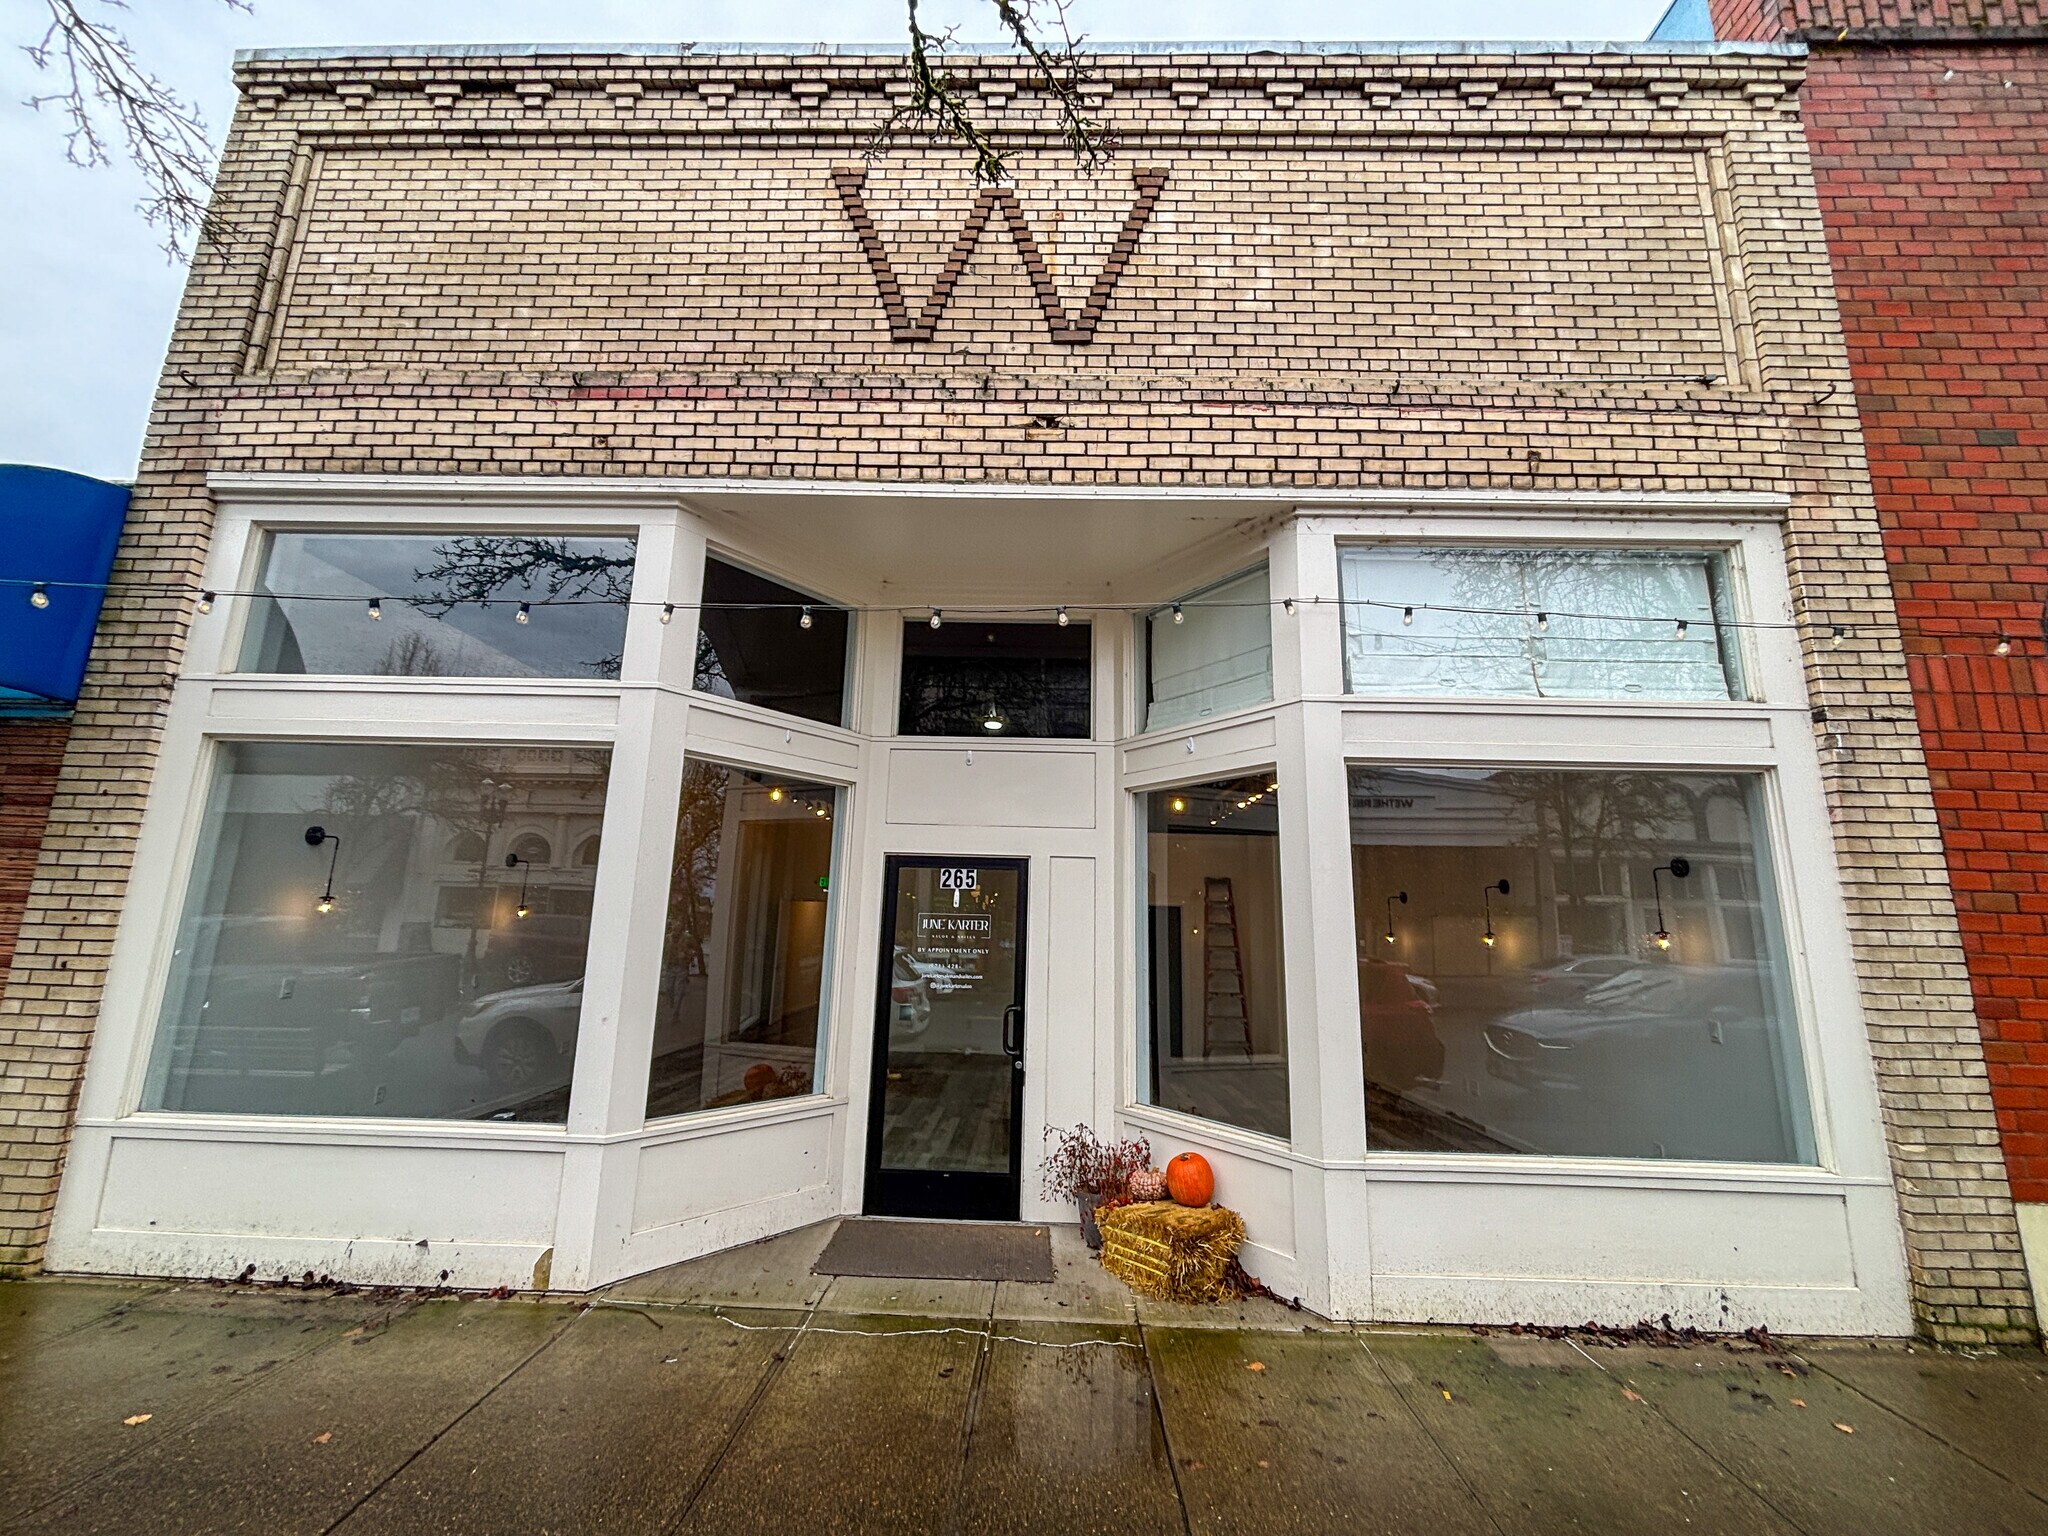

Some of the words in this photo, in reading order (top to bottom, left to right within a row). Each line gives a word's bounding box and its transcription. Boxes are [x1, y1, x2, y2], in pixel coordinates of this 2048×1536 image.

[831, 167, 1169, 345] W
[941, 869, 975, 888] 265
[922, 918, 946, 930] JUNE
[947, 919, 989, 931] KARTER
